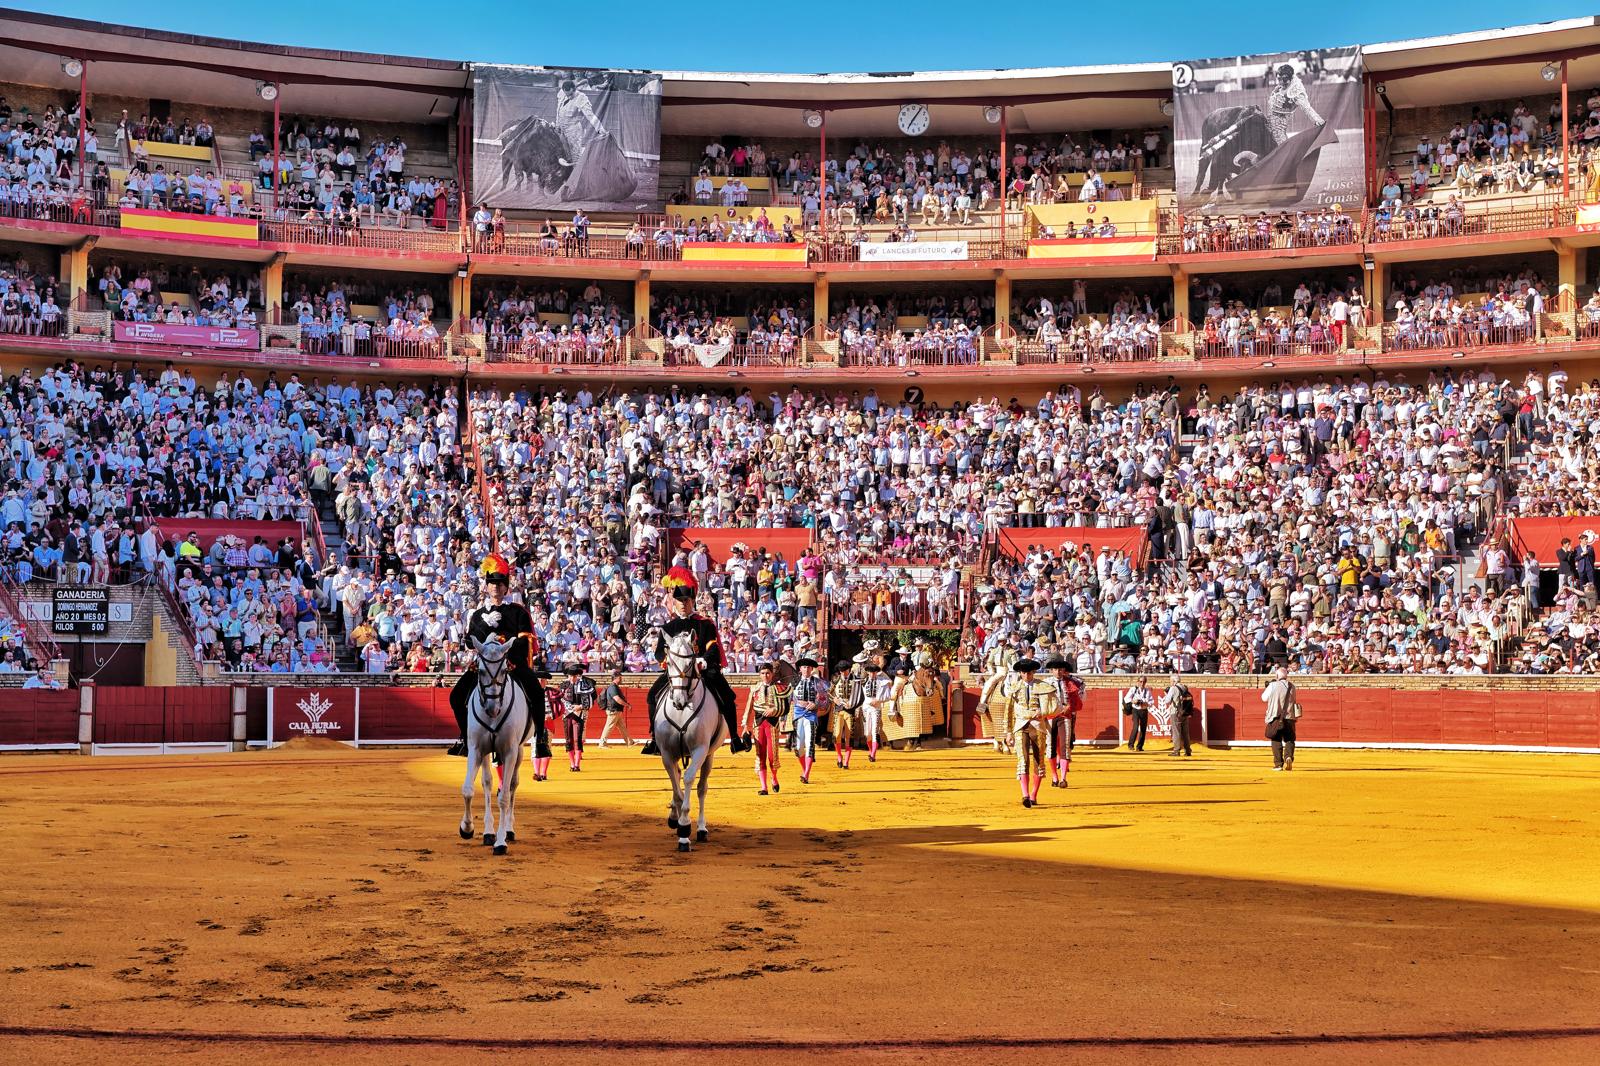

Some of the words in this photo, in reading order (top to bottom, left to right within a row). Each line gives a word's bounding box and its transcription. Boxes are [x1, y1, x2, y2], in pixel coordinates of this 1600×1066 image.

[1176, 66, 1186, 84] 2
[1323, 177, 1354, 190] José
[1315, 190, 1360, 204] Tomás
[908, 389, 919, 403] 7
[56, 590, 106, 599] GANADERIA
[57, 603, 75, 611] DOMINGO
[55, 612, 69, 620] AÑO
[55, 623, 74, 631] KILOS
[91, 623, 105, 631] 500
[288, 722, 310, 730] CAJA
[311, 722, 341, 730] RURAL
